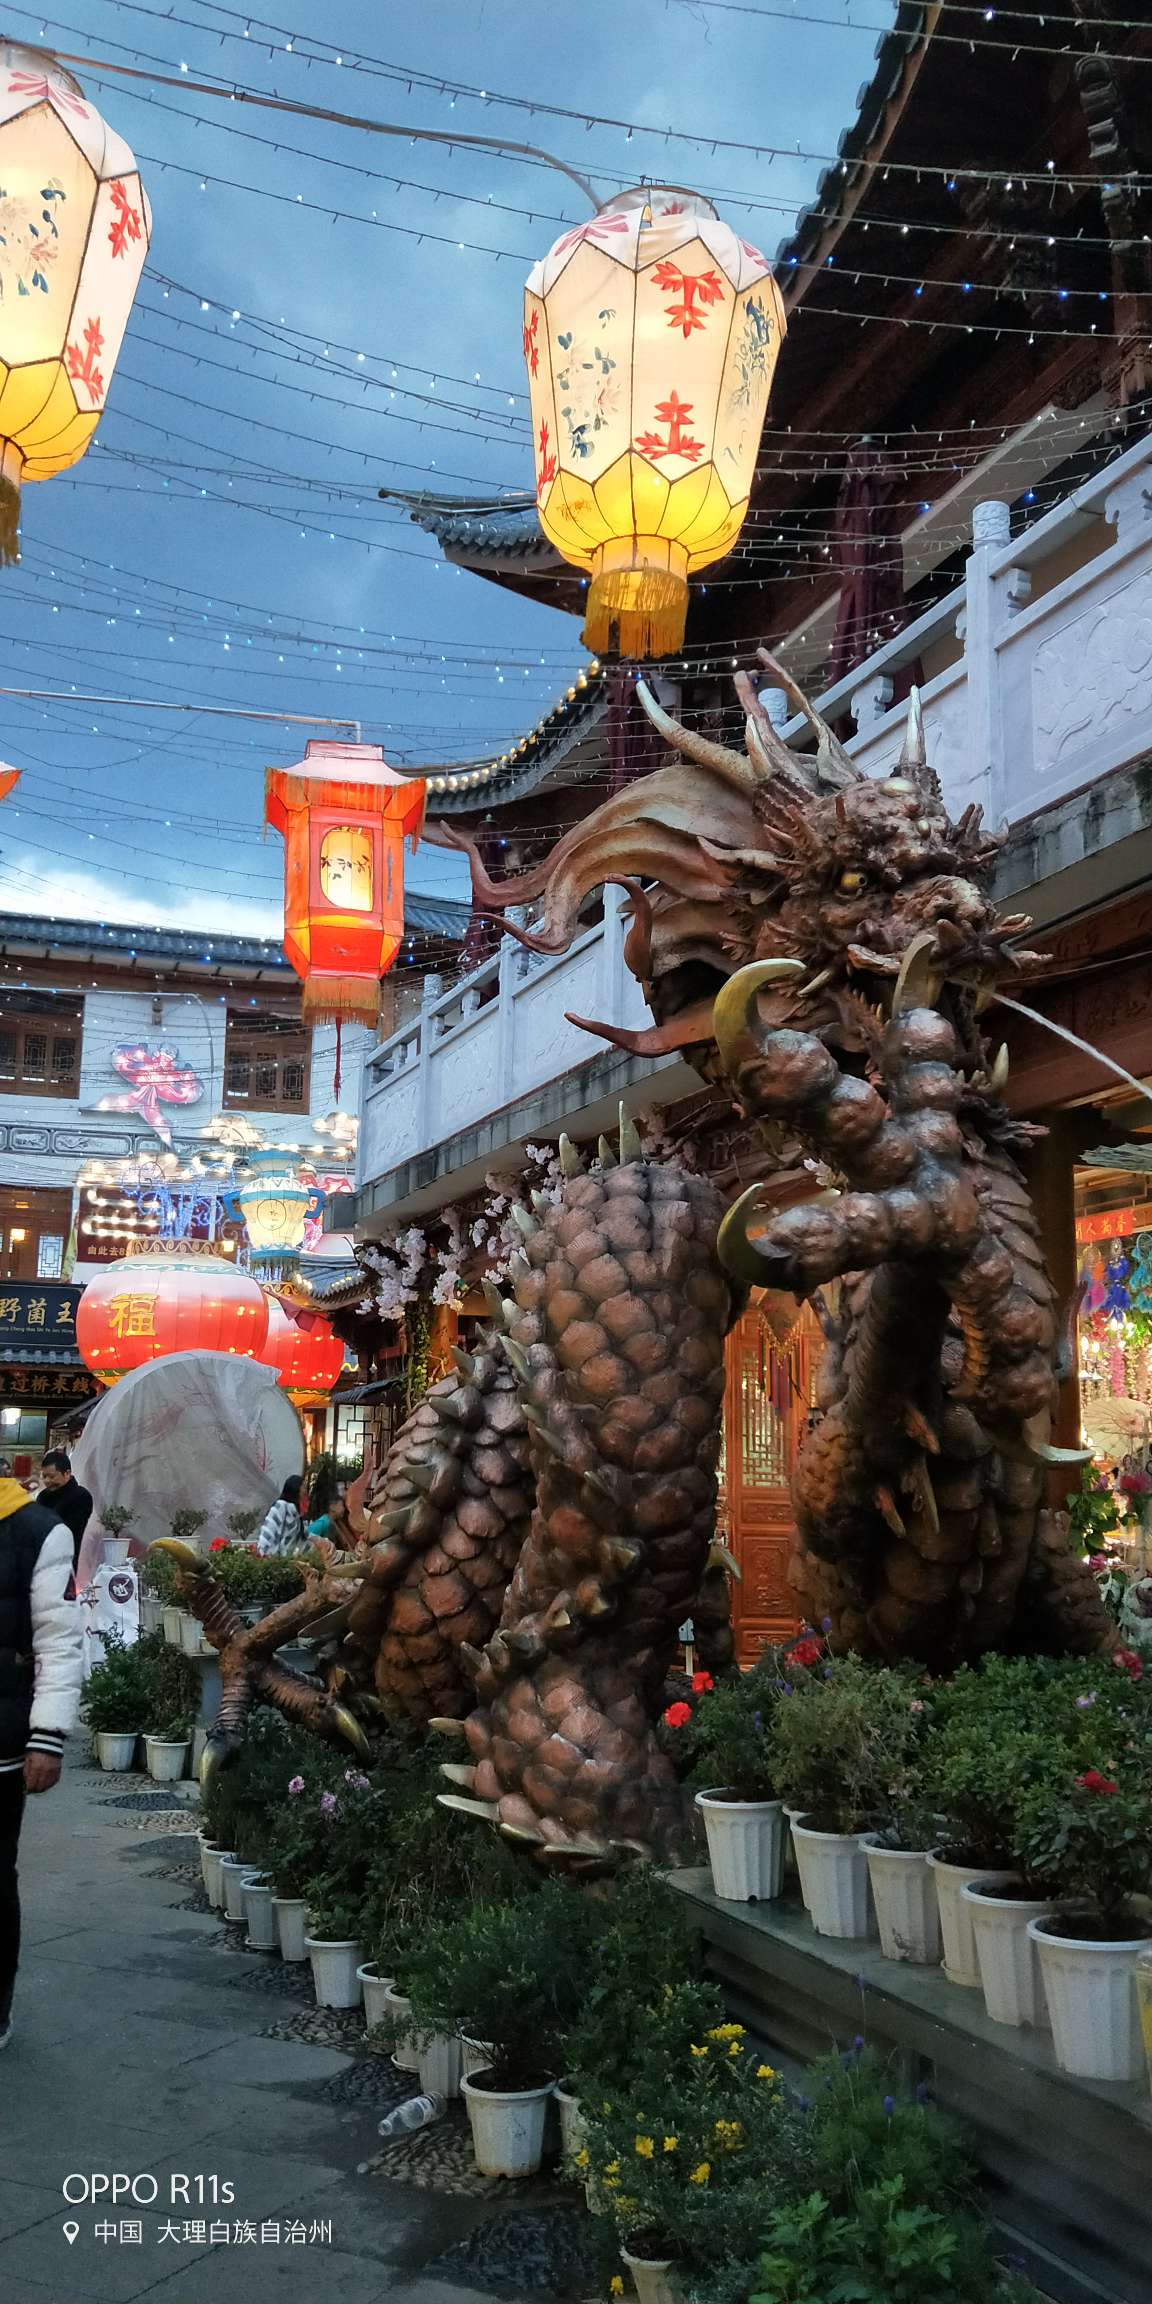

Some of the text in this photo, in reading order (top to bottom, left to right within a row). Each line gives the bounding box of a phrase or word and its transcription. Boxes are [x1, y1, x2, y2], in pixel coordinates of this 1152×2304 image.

[87, 1245, 129, 1257] 由此去8
[0, 1297, 75, 1326] 野菌王
[109, 1292, 160, 1339] 福
